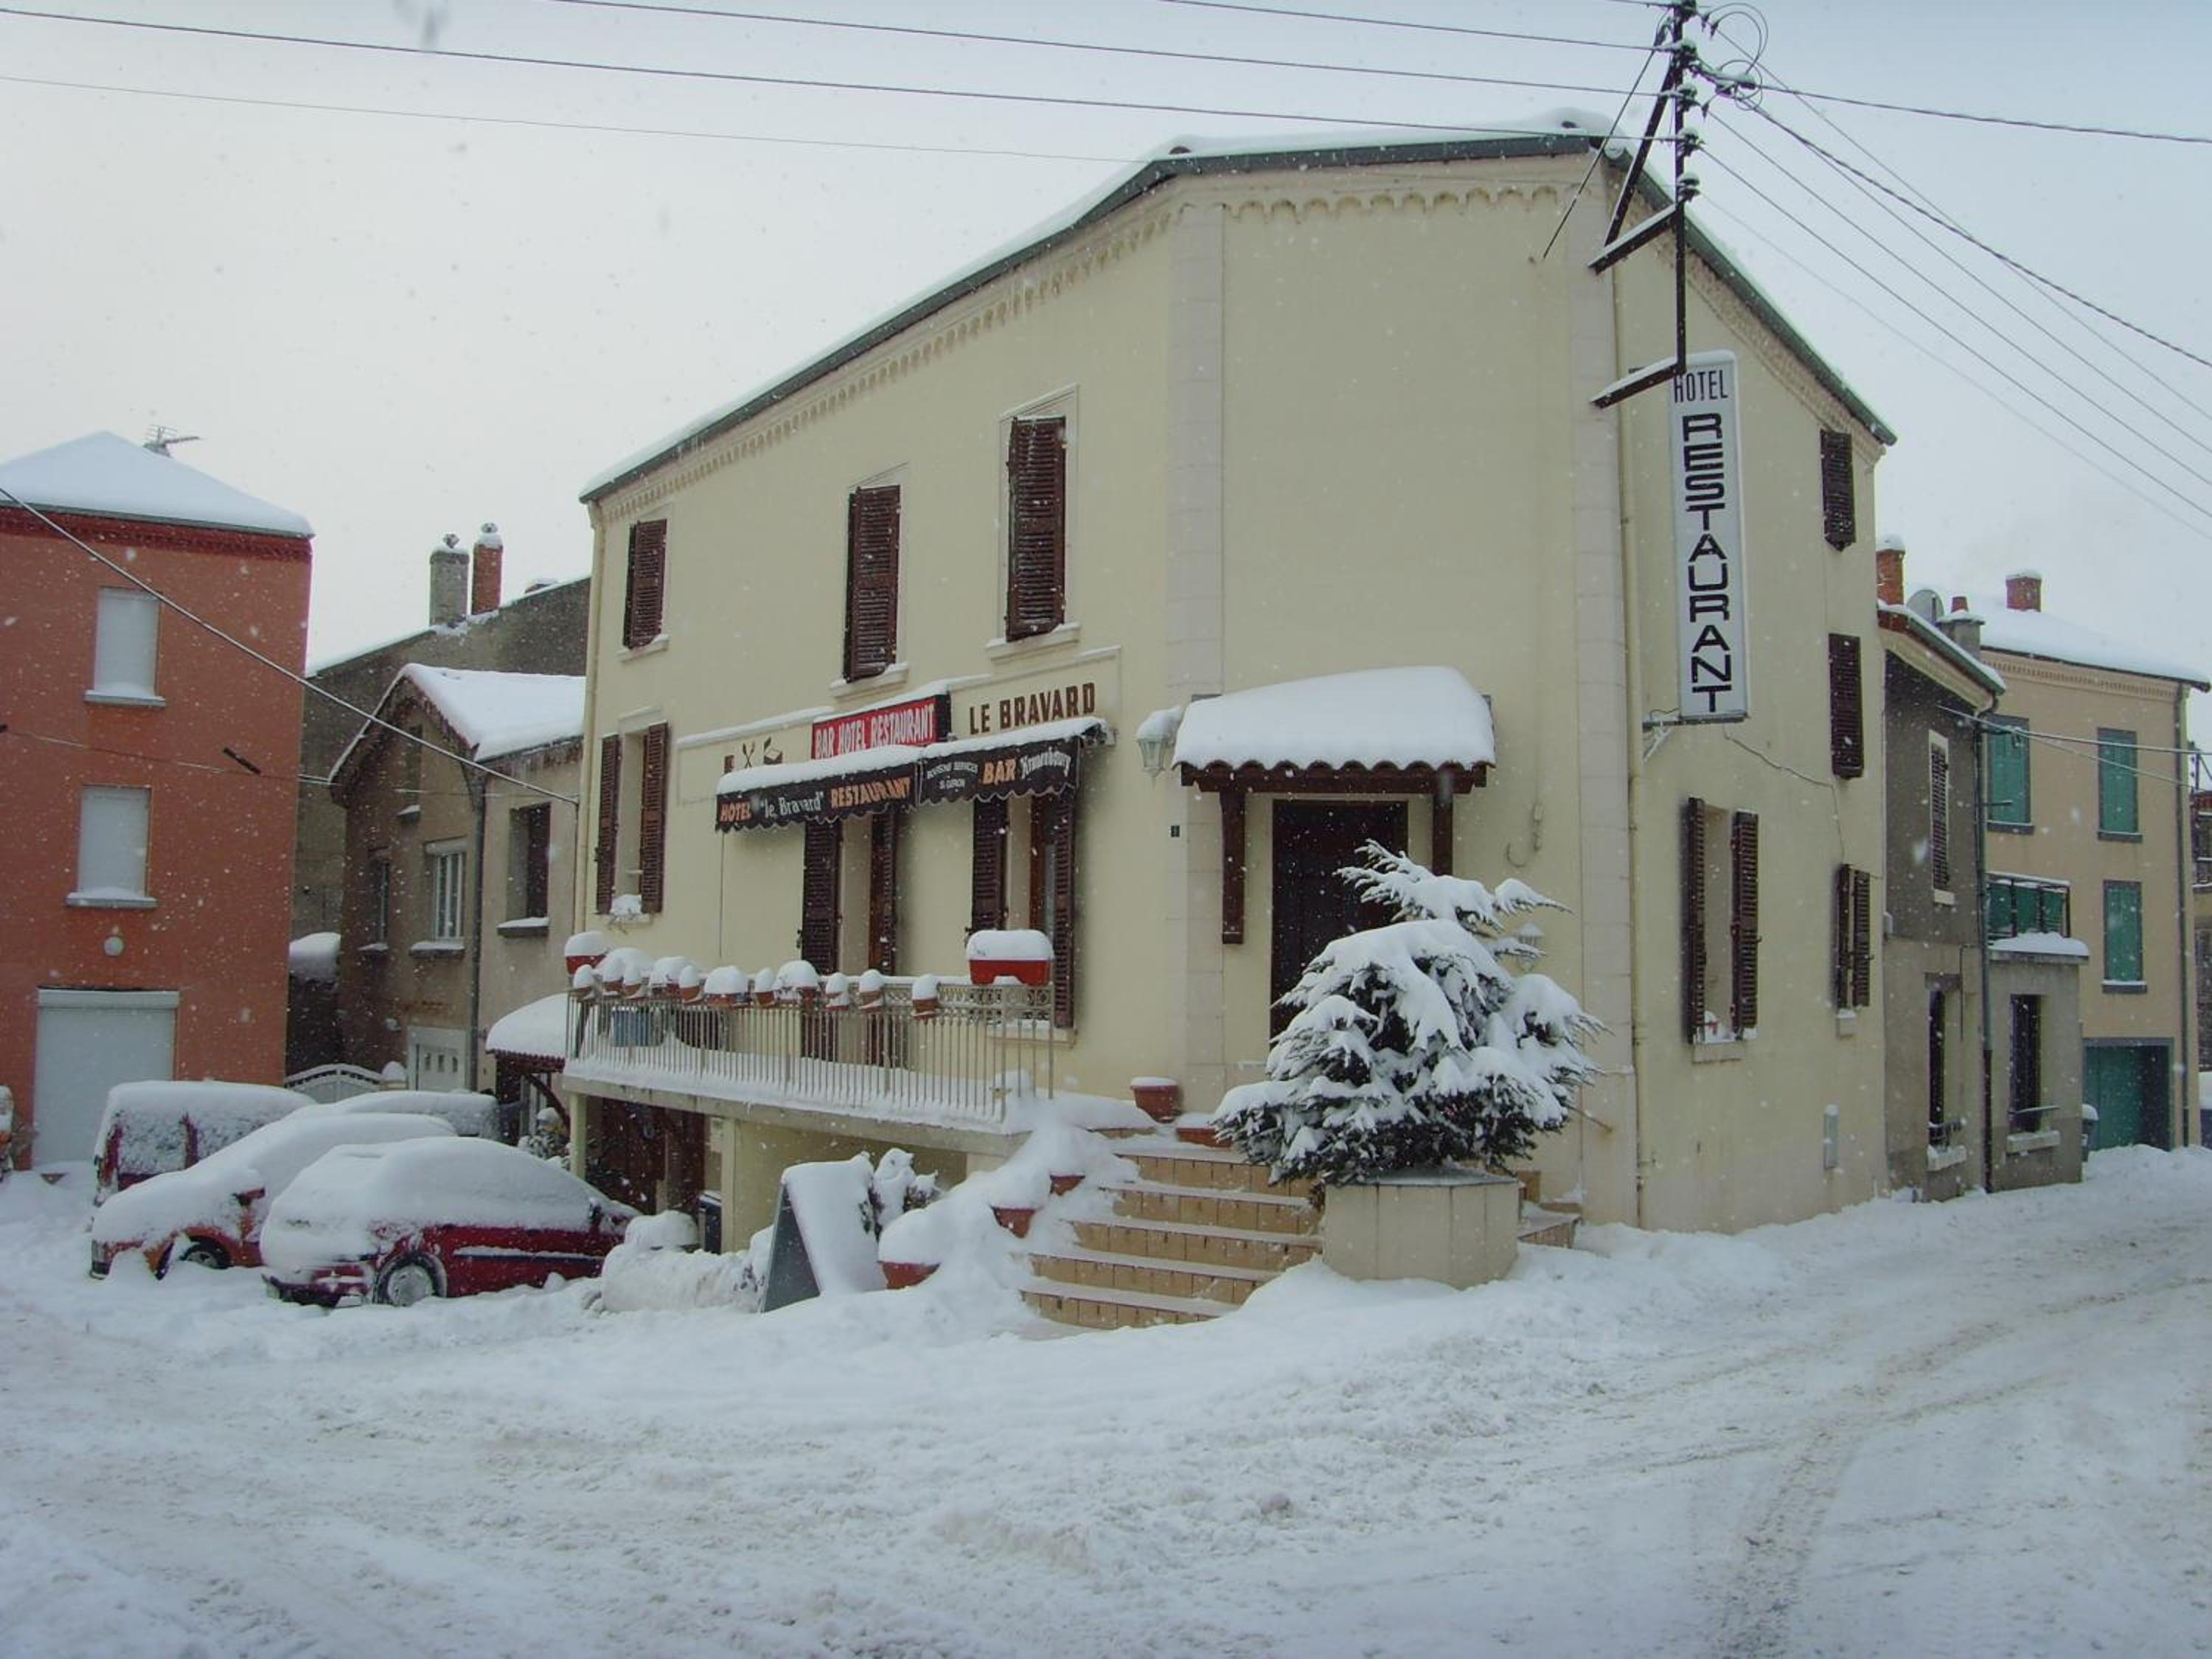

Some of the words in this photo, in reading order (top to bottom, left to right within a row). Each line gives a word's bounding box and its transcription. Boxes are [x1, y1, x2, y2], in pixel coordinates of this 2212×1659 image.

[1674, 369, 1728, 403] HOTEL
[1682, 412, 1732, 712] RESTAURANT
[815, 726, 835, 759] BAR
[838, 719, 866, 757] HOTEL
[870, 703, 935, 750] RESTAURANT
[970, 703, 990, 735] LE
[999, 682, 1095, 729] BRAVARD
[983, 757, 1017, 785] BAR
[720, 800, 752, 823] HOTEL
[830, 776, 911, 809] RESTAURANT
